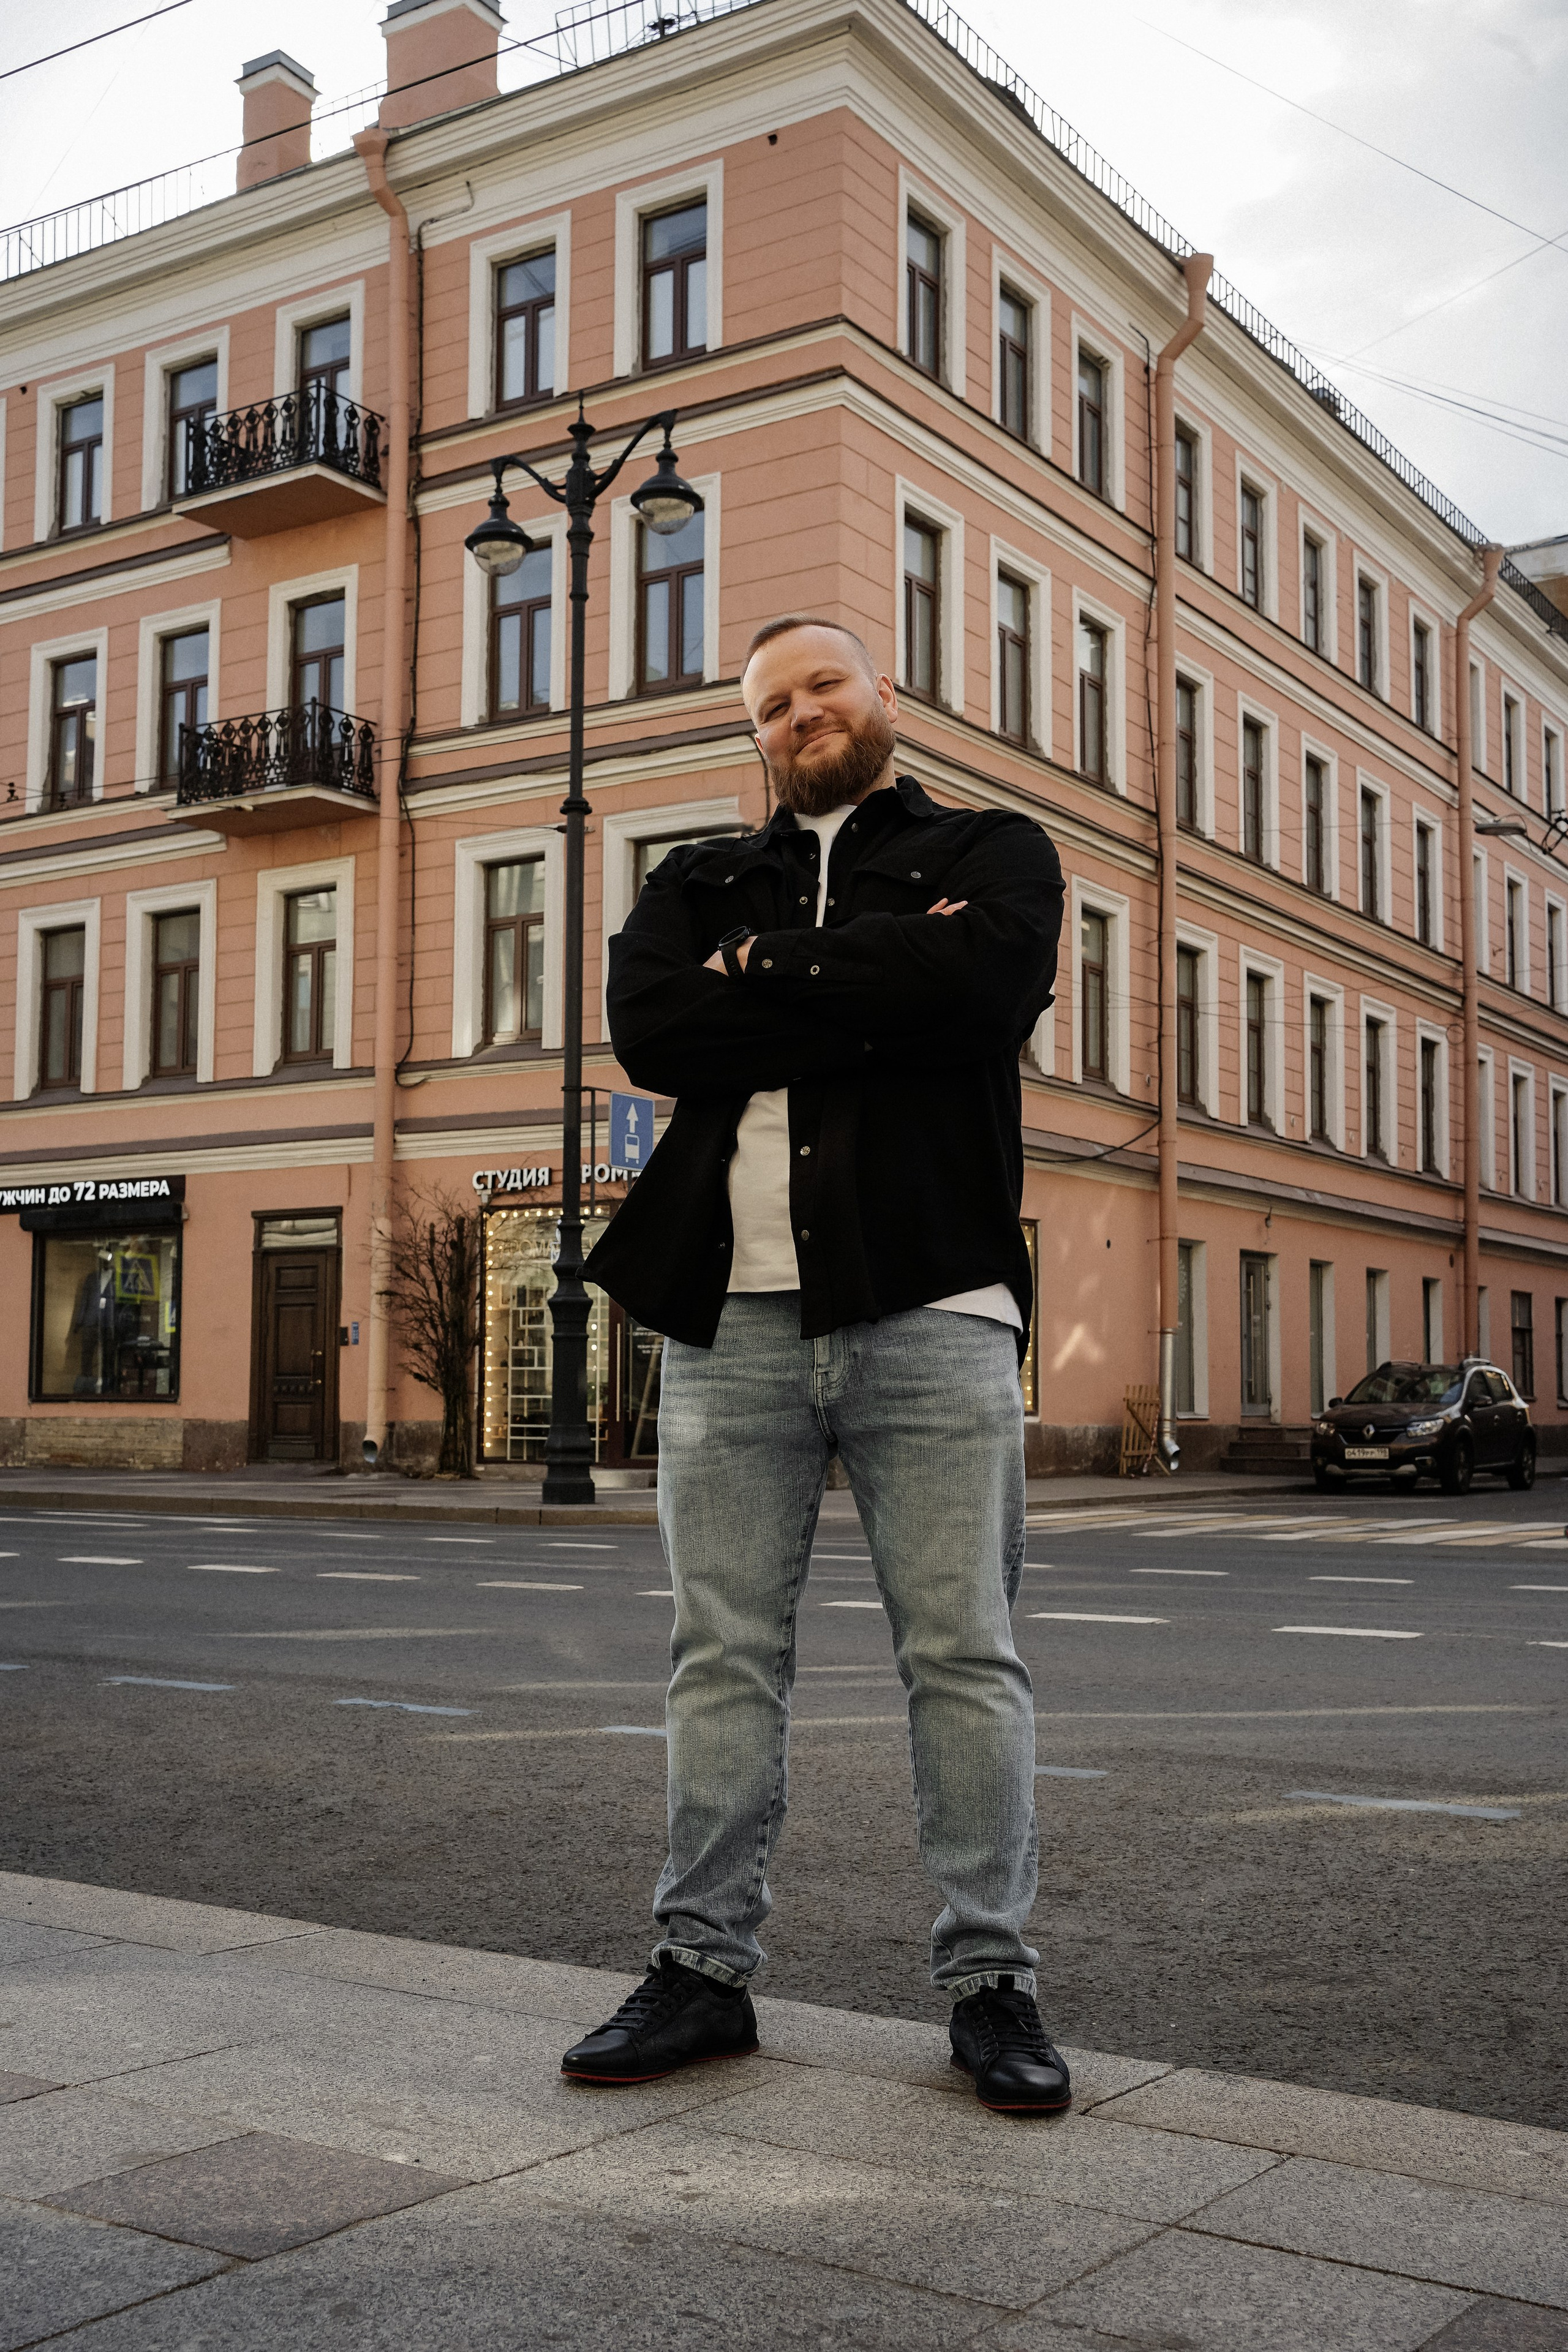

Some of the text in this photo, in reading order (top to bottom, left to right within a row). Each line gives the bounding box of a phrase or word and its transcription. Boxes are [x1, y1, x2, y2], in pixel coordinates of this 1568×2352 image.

[472, 1167, 549, 1191] СТУДИЯ
[48, 1186, 71, 1204] ДО
[74, 1181, 96, 1201] 72
[99, 1180, 170, 1199] РАЗМЕРА
